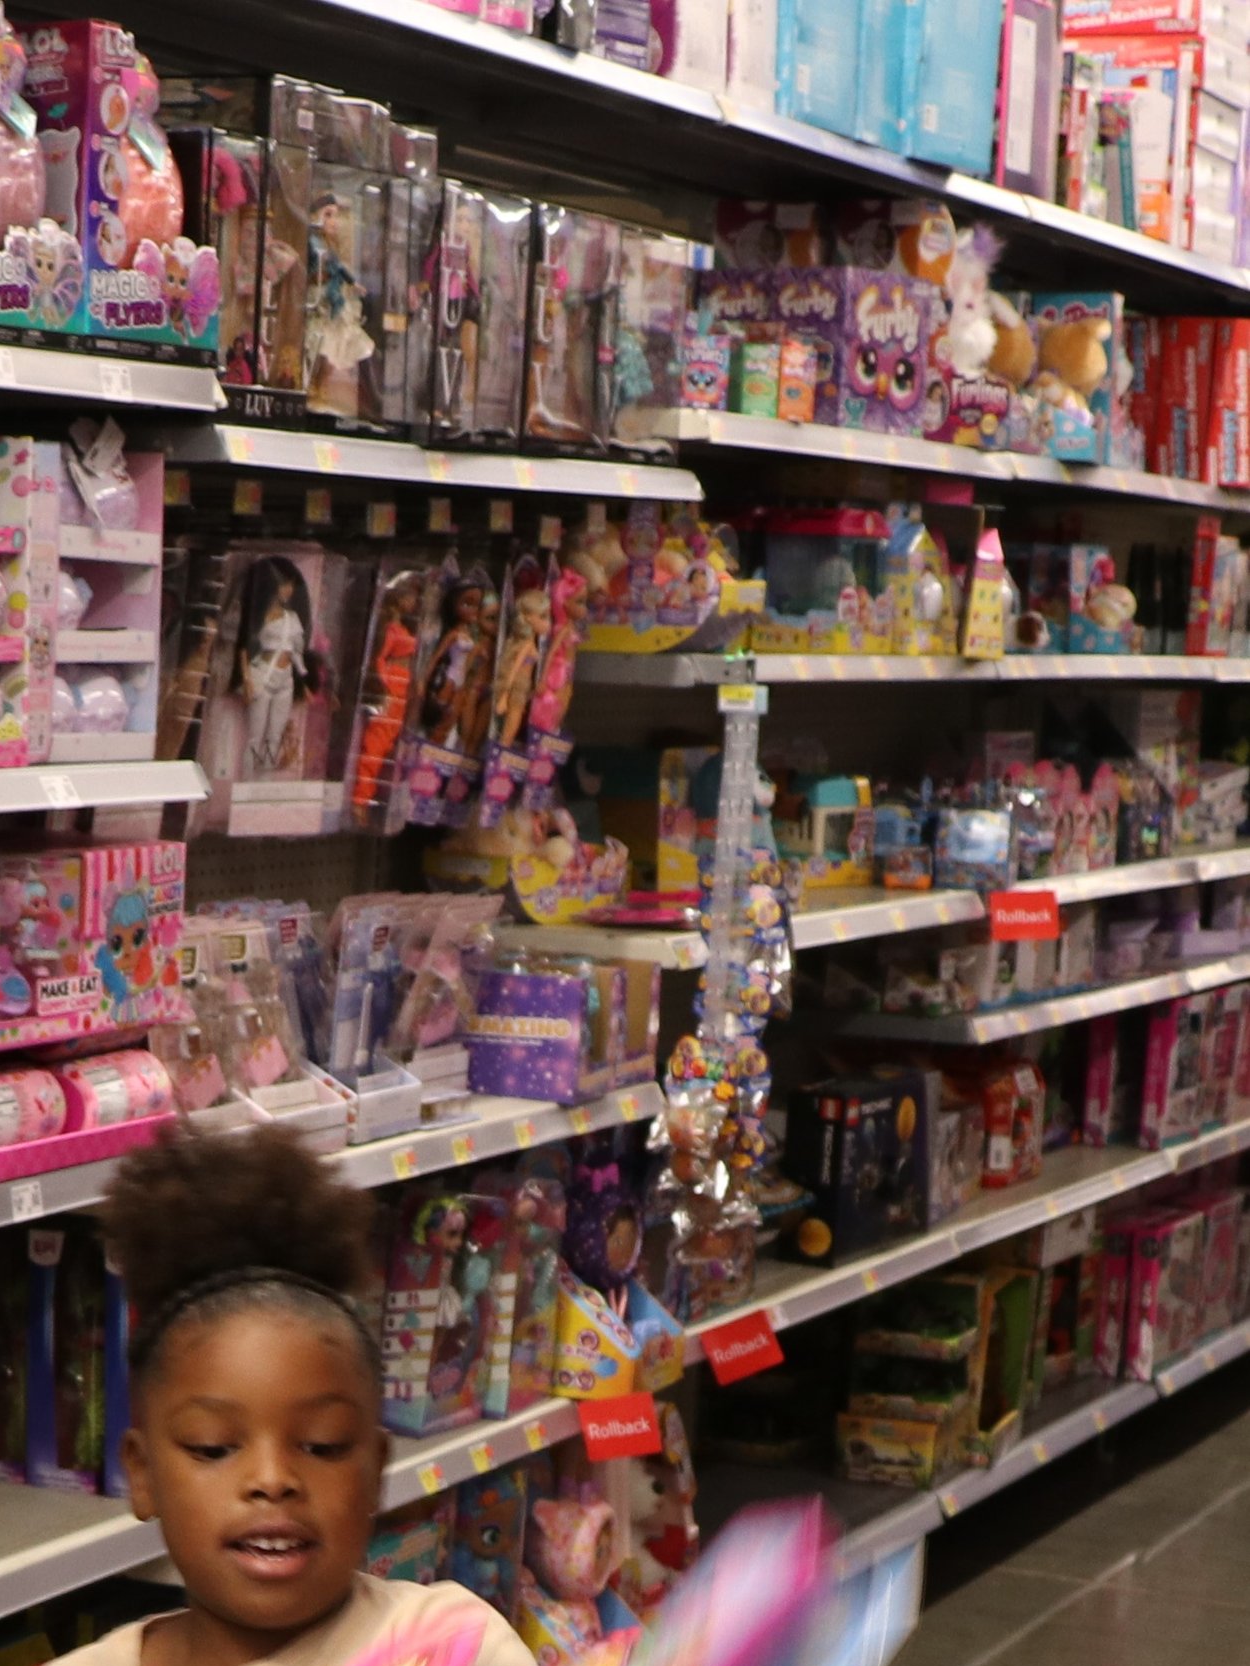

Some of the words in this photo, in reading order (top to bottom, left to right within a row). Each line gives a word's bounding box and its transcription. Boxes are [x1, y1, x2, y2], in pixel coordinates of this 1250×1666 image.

[857, 285, 920, 351] Furby
[997, 906, 1053, 926] Rollback
[40, 981, 69, 997] MAKE
[79, 977, 98, 992] EAT
[714, 1332, 769, 1363] Rollback
[588, 1417, 650, 1440] Rollback
